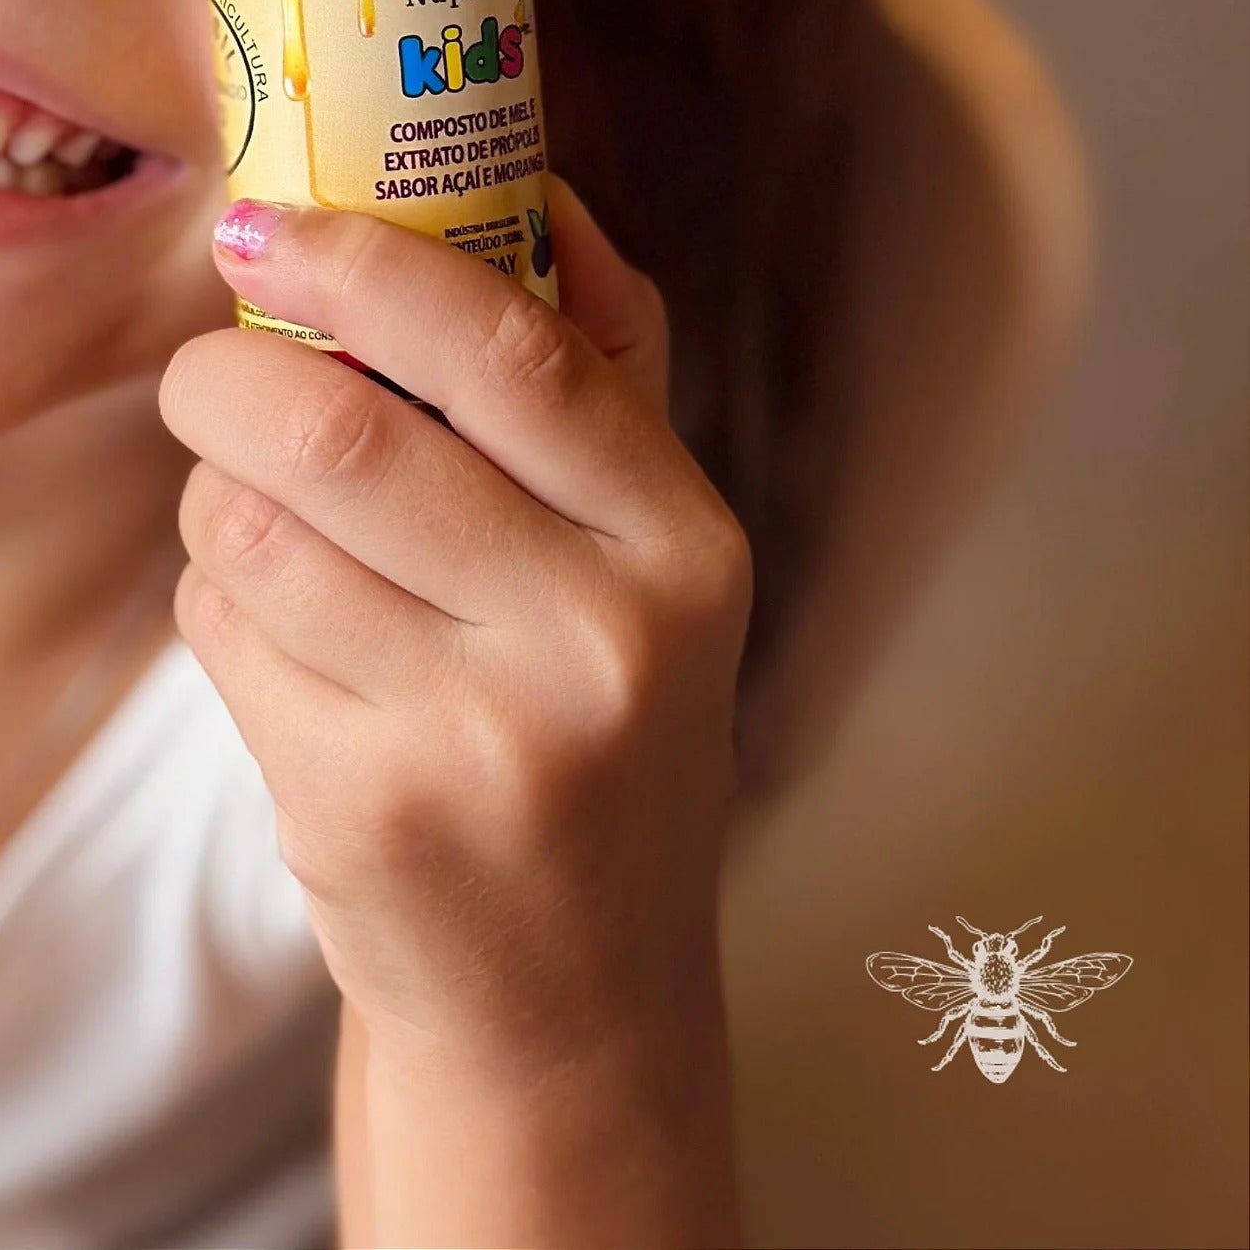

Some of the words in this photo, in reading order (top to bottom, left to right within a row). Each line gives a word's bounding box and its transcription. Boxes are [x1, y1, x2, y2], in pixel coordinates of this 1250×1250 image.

[398, 16, 524, 98] kids
[390, 112, 487, 143] COMPOSTO
[489, 107, 508, 129] DE
[509, 101, 530, 125] MEL
[384, 144, 464, 171] EXTRATO
[467, 140, 488, 162] DE
[375, 176, 438, 200] SABOR
[442, 165, 480, 197] AÇAÍ
[483, 167, 492, 187] E
